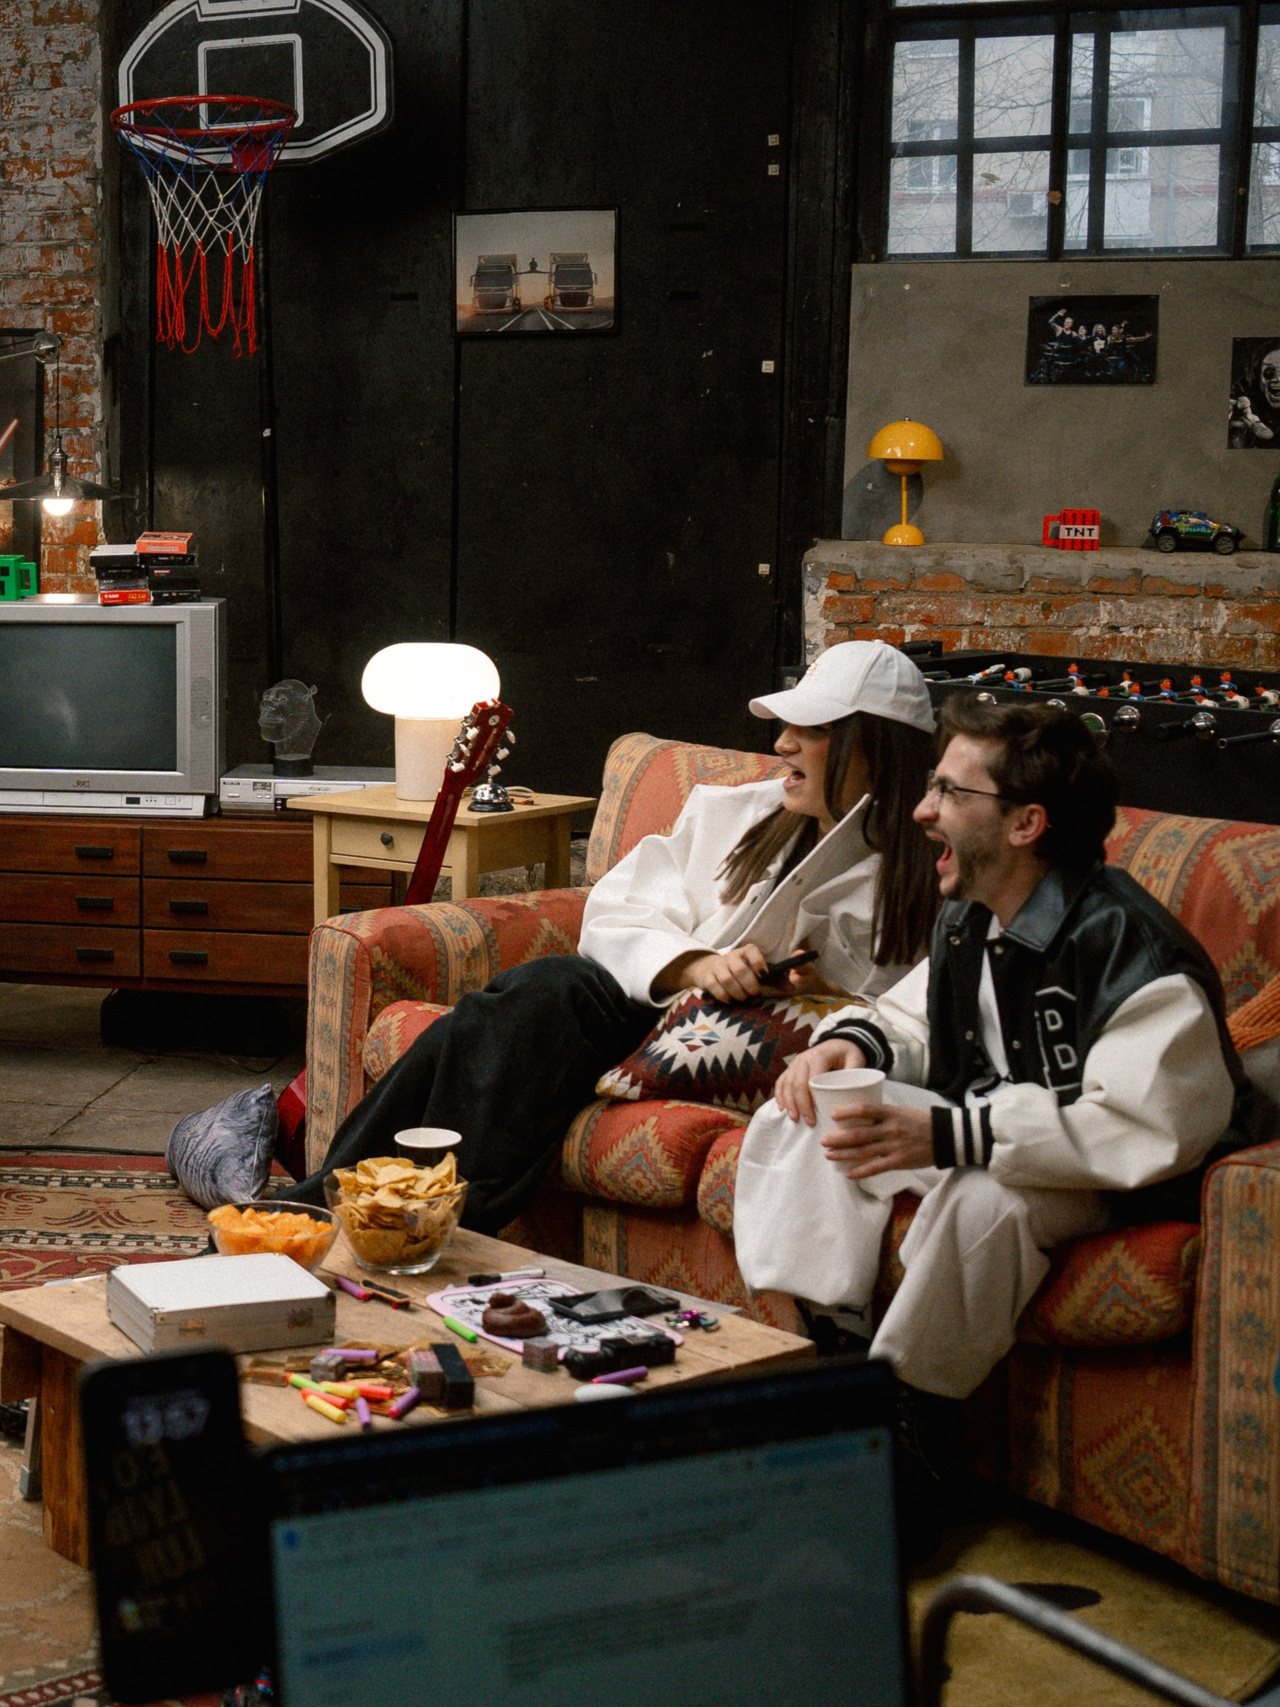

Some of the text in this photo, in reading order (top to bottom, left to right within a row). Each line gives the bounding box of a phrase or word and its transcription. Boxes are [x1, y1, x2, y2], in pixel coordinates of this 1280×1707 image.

[1064, 527, 1096, 538] TNT
[1044, 1009, 1063, 1031] D
[1053, 1044, 1077, 1070] D
